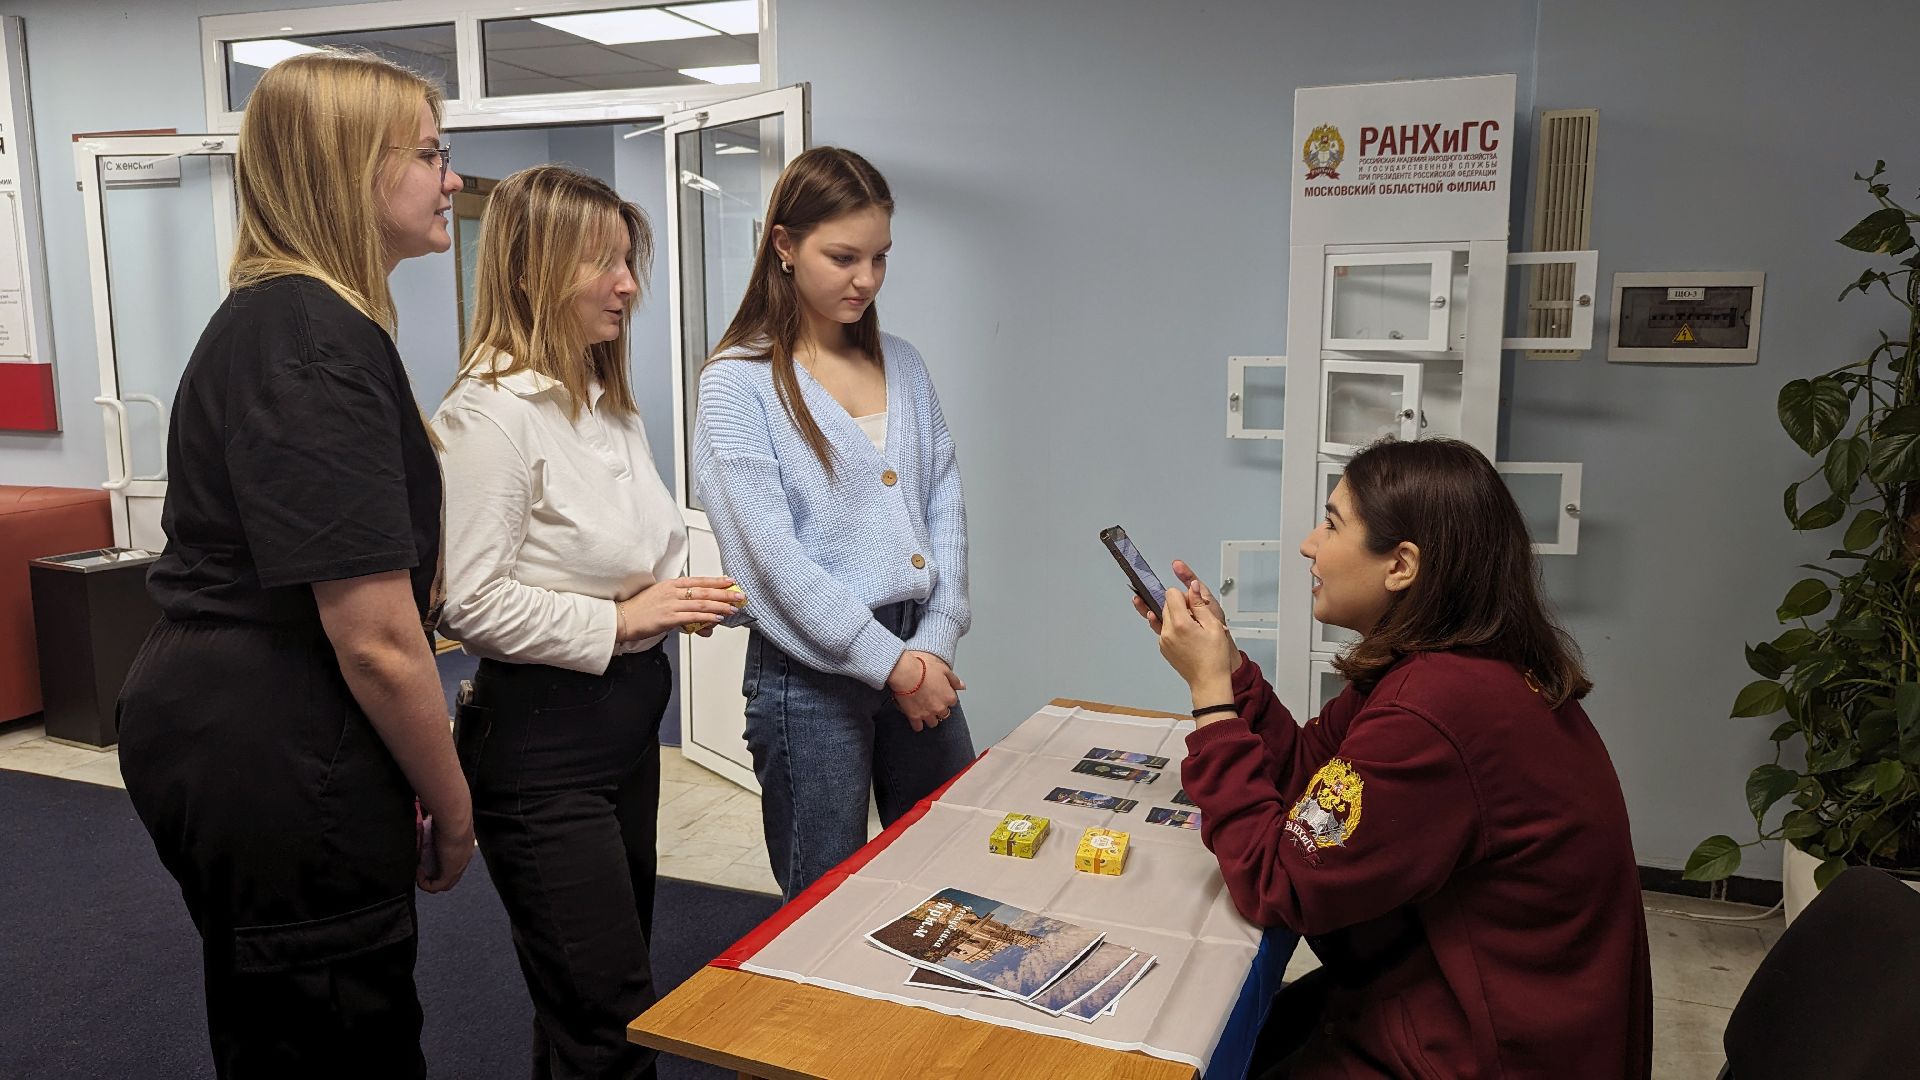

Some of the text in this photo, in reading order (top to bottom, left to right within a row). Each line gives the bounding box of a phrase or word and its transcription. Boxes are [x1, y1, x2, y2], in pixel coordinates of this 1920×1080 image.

[1359, 120, 1499, 156] РАНХиГС
[1458, 161, 1498, 169] СЛУЖБЫ
[1371, 172, 1412, 180] ПРЕЗИДЕНТЕ
[1457, 169, 1497, 177] ФЕДЕРАЦИИ
[1304, 180, 1496, 197] МОСКОВСКИЙ ОБЛАСТНОЙ ФИЛИАЛ
[912, 901, 953, 938] Крым
